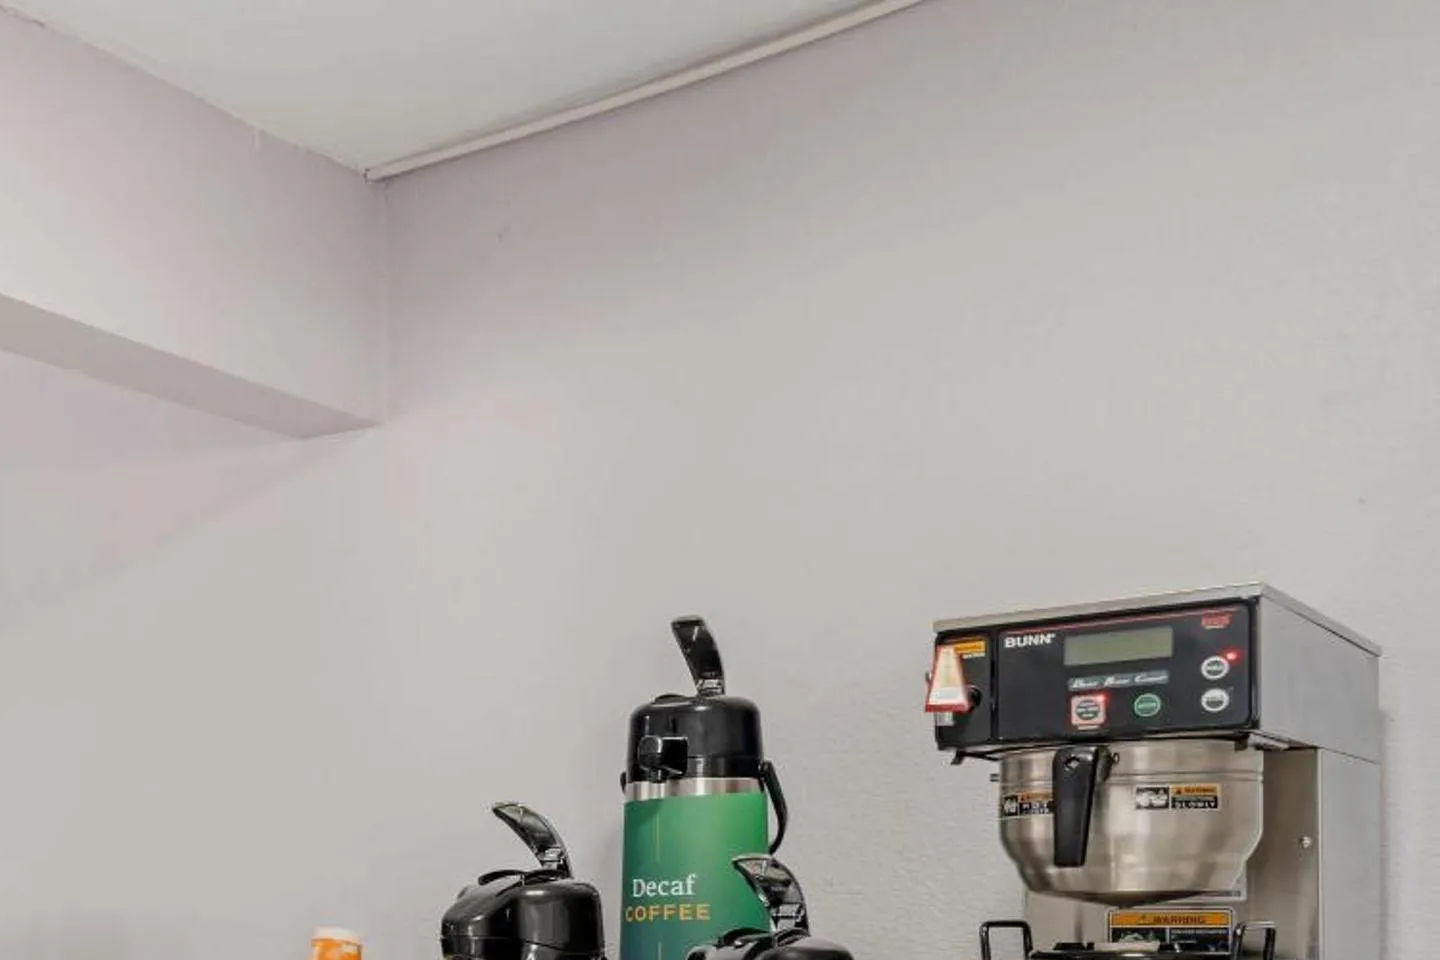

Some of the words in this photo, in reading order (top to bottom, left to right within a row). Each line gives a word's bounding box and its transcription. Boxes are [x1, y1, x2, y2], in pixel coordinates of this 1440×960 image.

[1004, 633, 1053, 648] BUNN
[632, 873, 697, 897] Decaf
[624, 903, 711, 923] COFFEE
